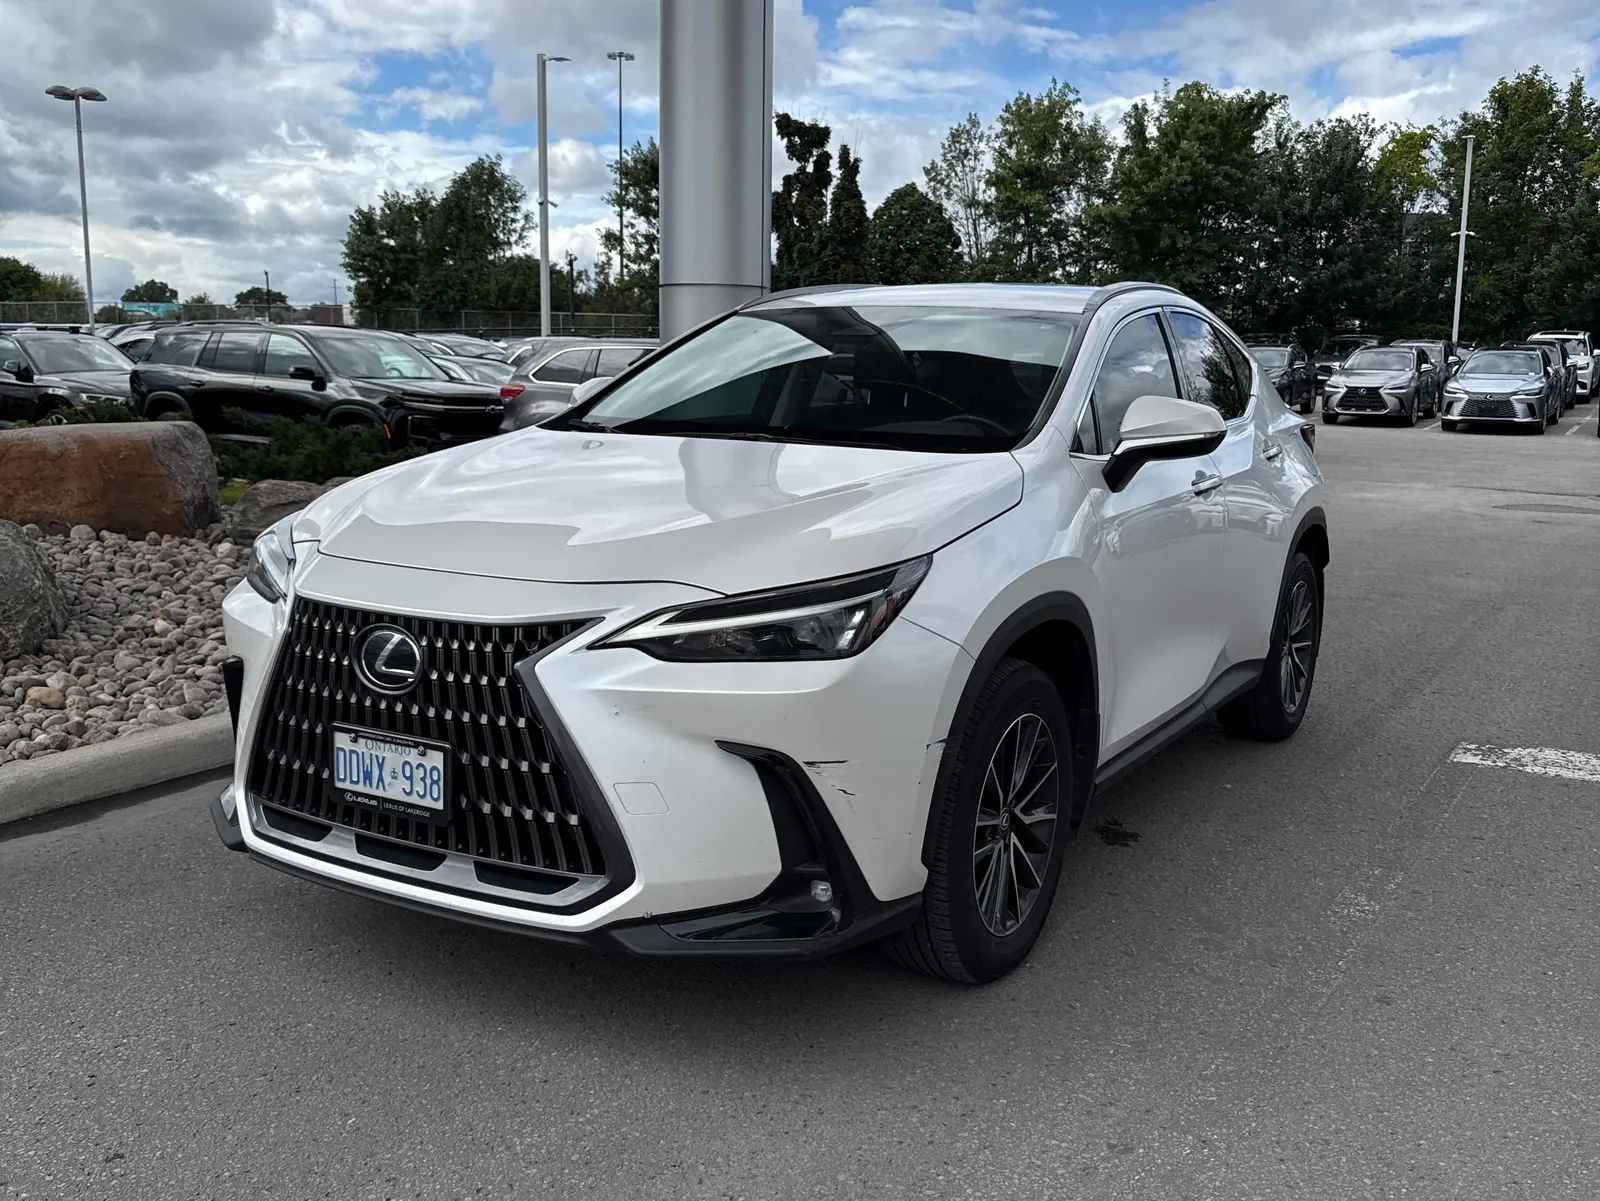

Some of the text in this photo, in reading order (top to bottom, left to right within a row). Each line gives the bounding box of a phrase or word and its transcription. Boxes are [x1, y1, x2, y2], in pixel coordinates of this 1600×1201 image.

[365, 739, 411, 756] ONTARIO
[336, 746, 441, 802] DDWX 938
[353, 796, 378, 806] LEXUS
[383, 802, 398, 811] LEXUS
